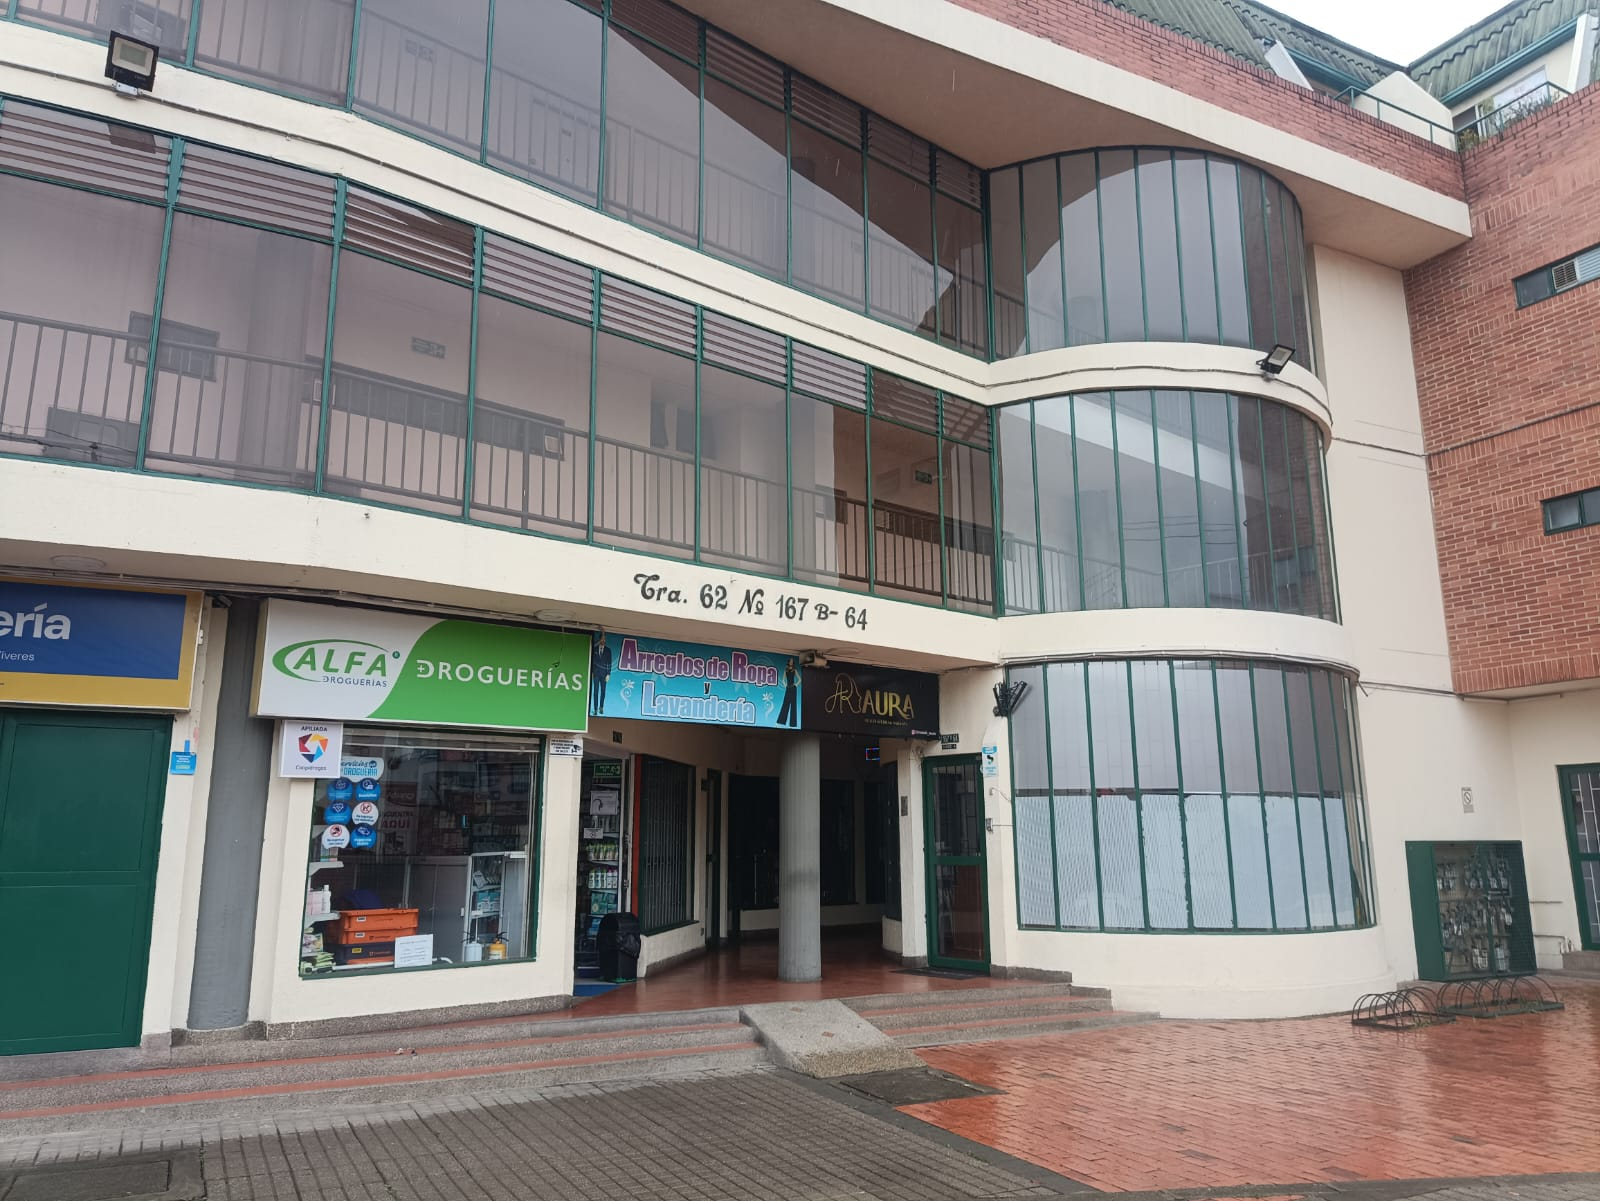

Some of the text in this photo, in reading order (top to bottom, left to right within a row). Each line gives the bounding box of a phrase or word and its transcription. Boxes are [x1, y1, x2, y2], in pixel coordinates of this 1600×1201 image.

[700, 583, 728, 610] 62
[775, 594, 810, 621] 167
[845, 606, 868, 630] 64
[293, 647, 387, 677] ALFA
[416, 659, 583, 691] DROGUERÍAS
[618, 638, 779, 687] Arreglos de Ropa
[641, 680, 756, 724] Lavandería
[703, 681, 712, 695] y
[862, 689, 914, 719] AURA
